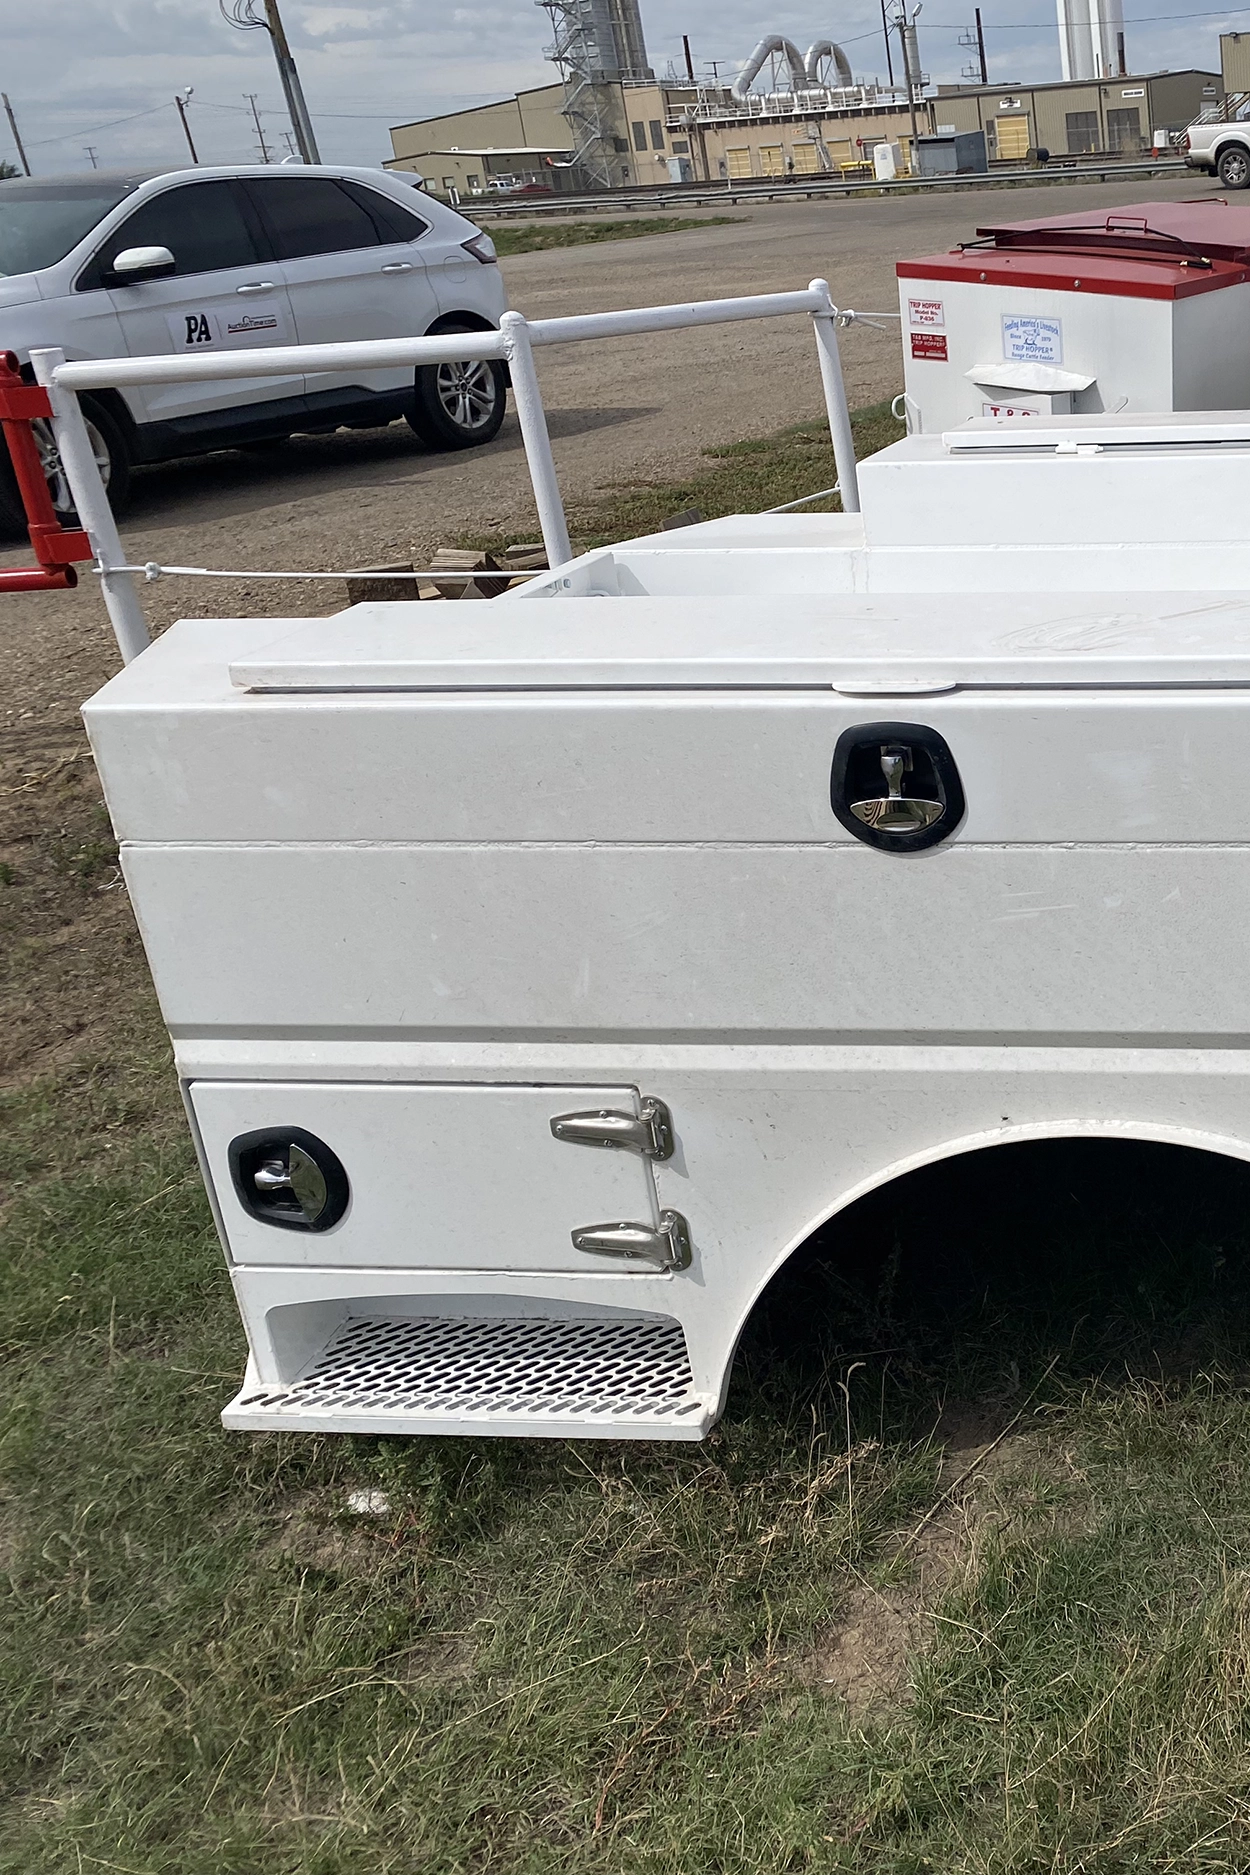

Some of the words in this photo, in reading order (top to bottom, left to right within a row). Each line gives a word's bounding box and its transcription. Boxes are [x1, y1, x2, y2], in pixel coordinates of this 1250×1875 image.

[184, 314, 212, 344] PA
[1005, 320, 1019, 331] Feeding
[1020, 318, 1039, 328] America's
[1040, 320, 1059, 336] Livestock
